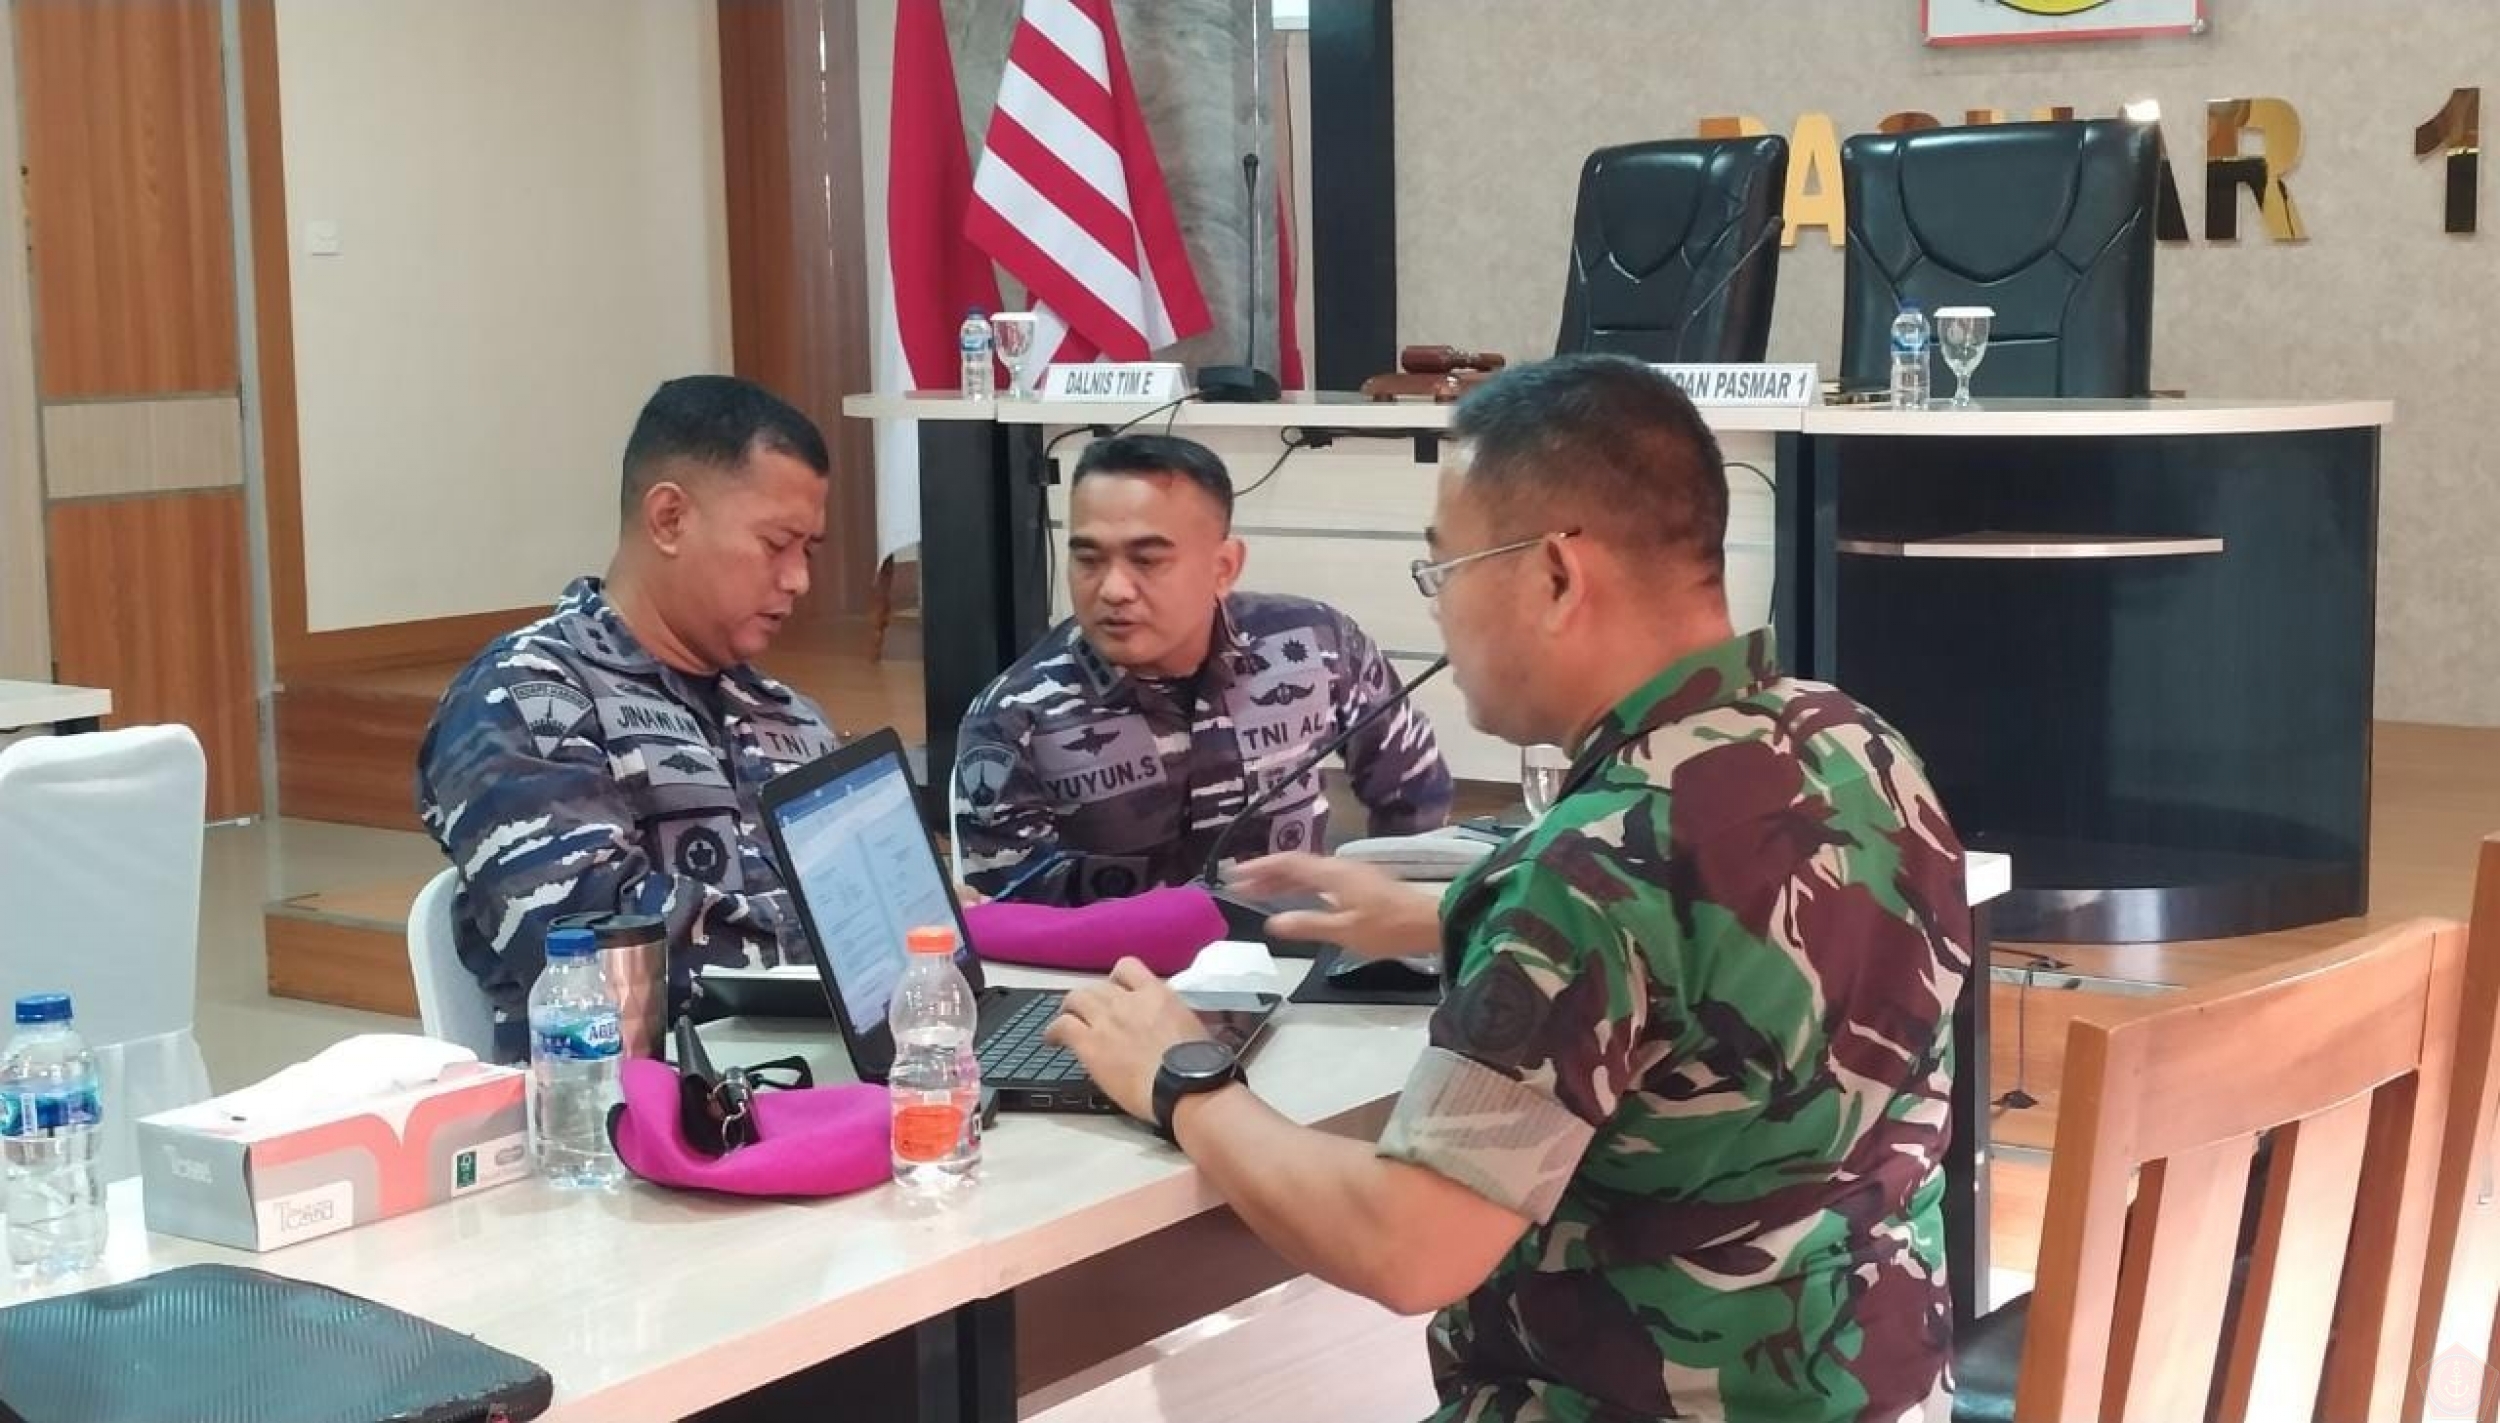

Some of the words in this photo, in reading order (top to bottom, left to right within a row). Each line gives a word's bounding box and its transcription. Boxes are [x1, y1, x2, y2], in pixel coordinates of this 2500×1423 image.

[2415, 87, 2480, 233] 1
[1066, 371, 1114, 395] DALNIS
[1117, 371, 1141, 396] TIM
[1141, 371, 1153, 395] E
[1714, 372, 1791, 399] PASMAR
[1798, 373, 1808, 398] 1
[765, 731, 811, 757] TNI
[1241, 721, 1288, 751] TNI
[1300, 712, 1323, 737] AL
[1045, 756, 1157, 800] YUYUN.S
